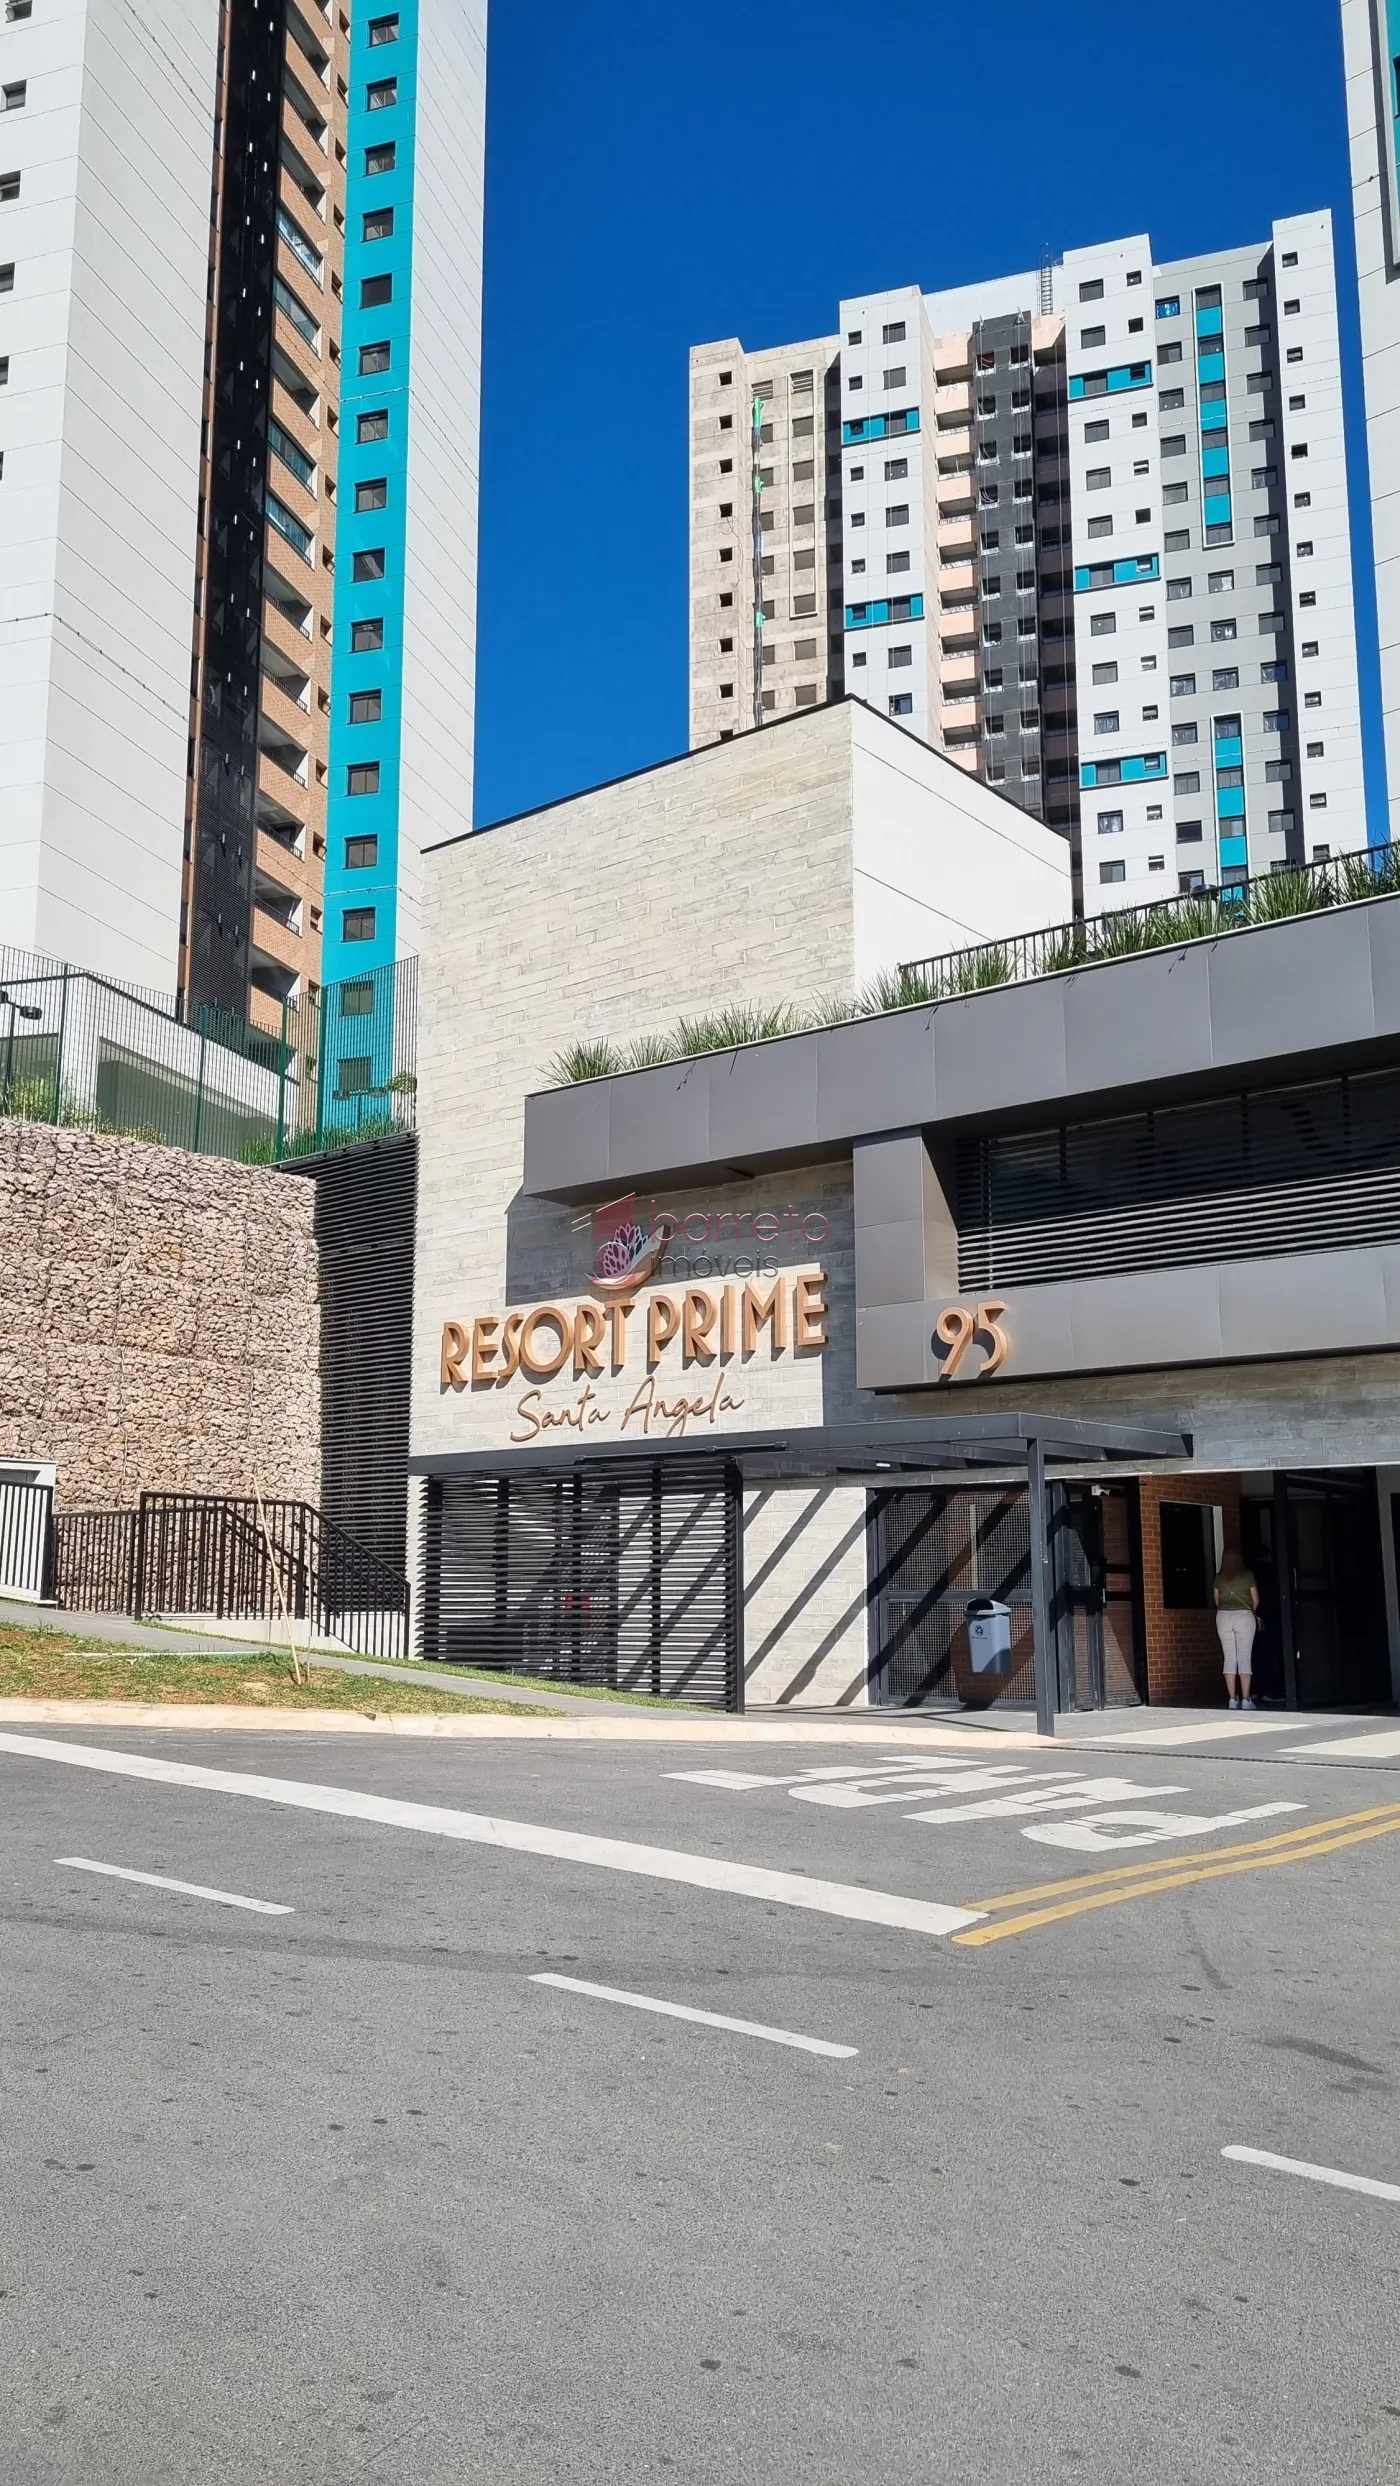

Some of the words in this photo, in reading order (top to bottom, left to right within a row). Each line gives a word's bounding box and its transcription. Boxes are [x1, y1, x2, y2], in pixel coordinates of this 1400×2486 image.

[441, 1299, 635, 1384] RESORT
[648, 1273, 829, 1363] PRIME
[936, 1300, 1009, 1376] 95
[510, 1384, 611, 1442] Santa
[621, 1372, 745, 1437] Angela
[659, 1755, 1308, 1852] PARE
